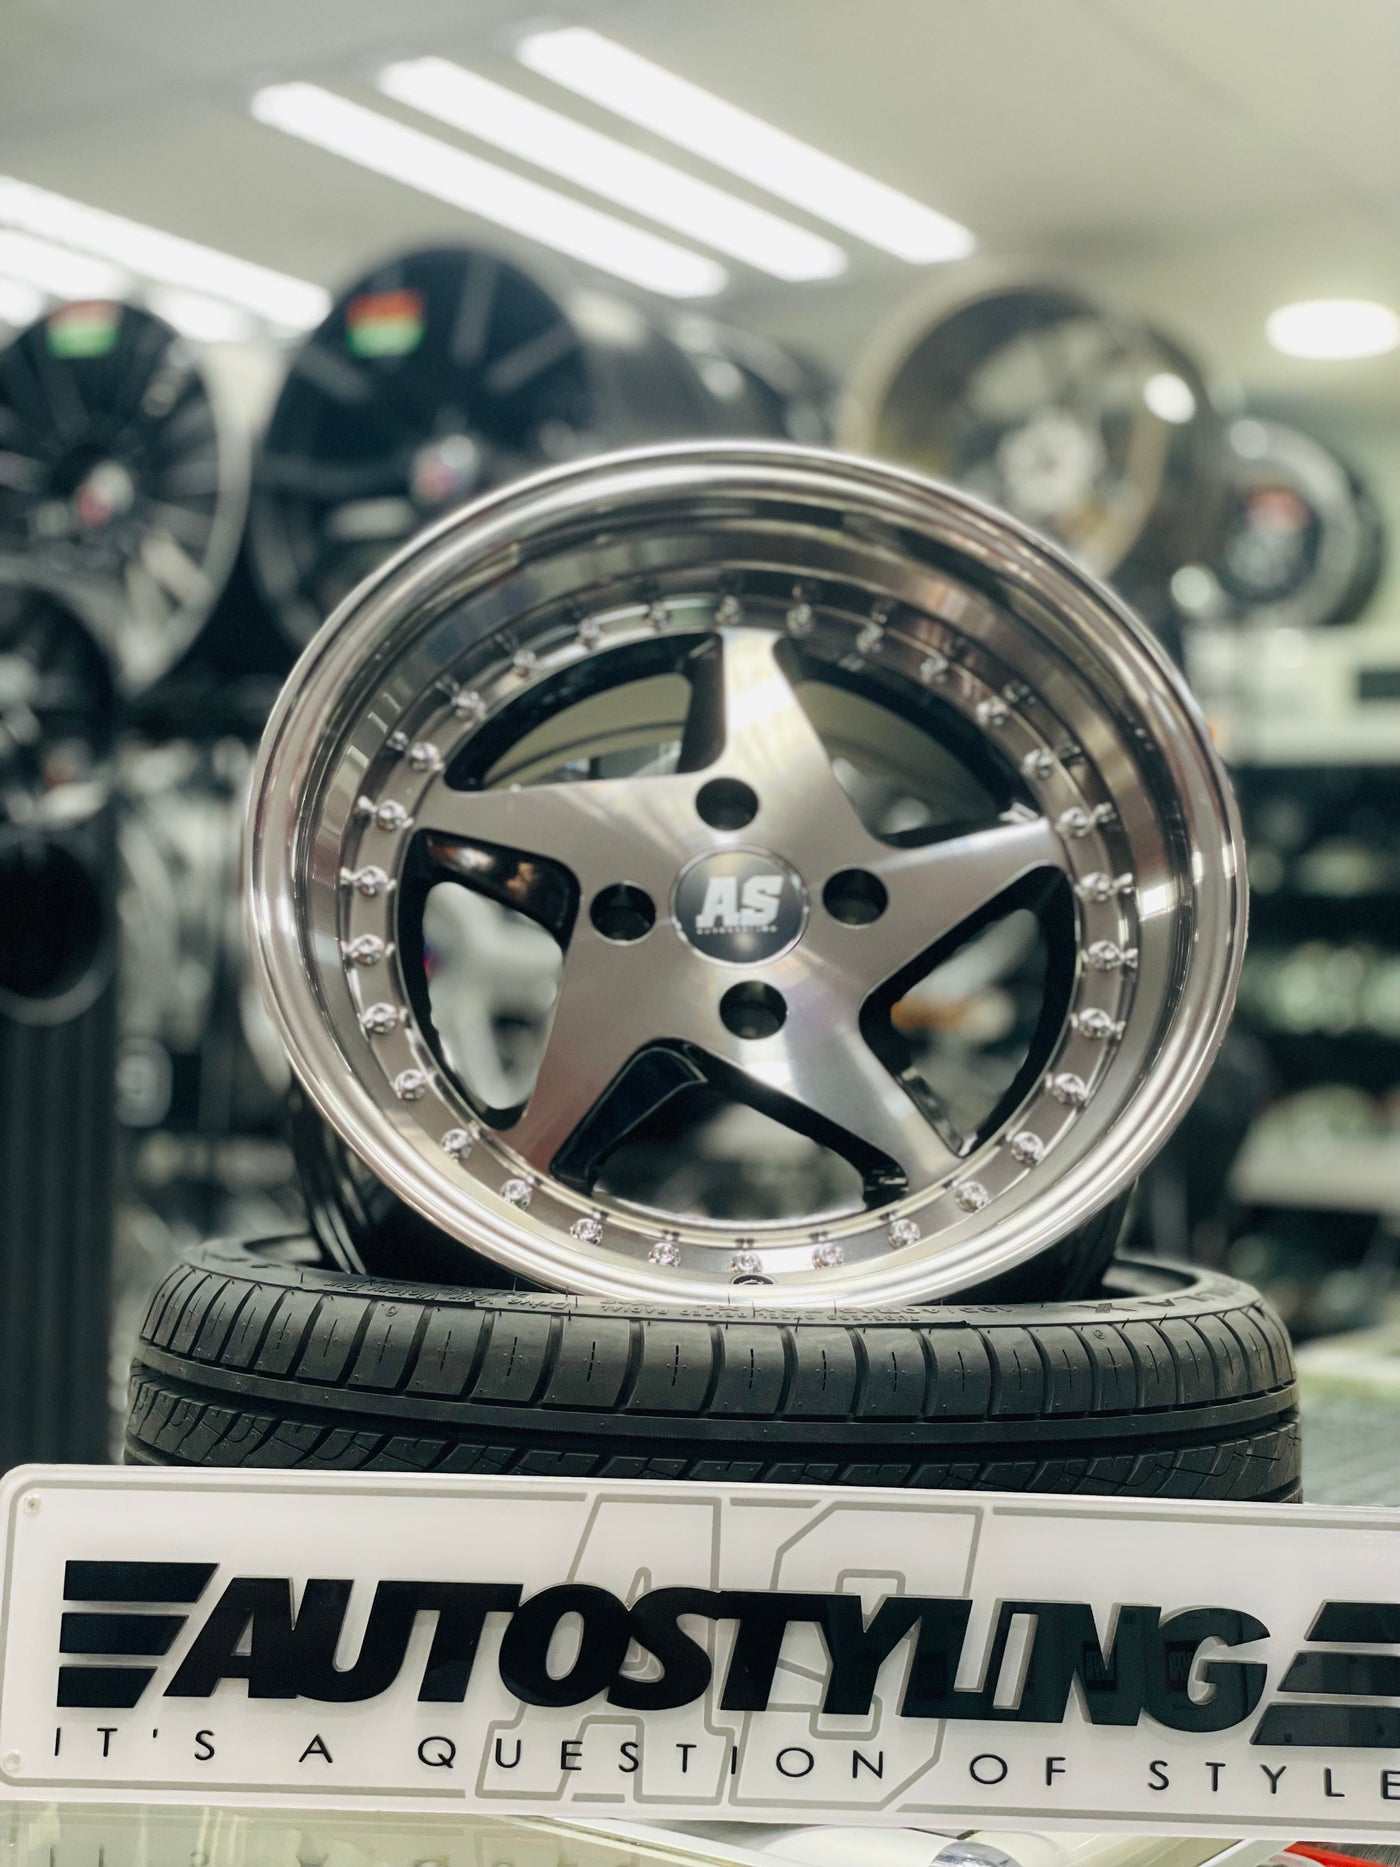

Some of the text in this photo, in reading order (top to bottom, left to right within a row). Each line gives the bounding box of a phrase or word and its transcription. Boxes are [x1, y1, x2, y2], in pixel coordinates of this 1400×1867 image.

[695, 874, 784, 929] AS
[449, 1294, 494, 1305] Your
[507, 1301, 571, 1311] Drive
[601, 1306, 668, 1316] RADIAL
[680, 1310, 747, 1319] BELTED
[163, 1576, 1270, 1733] AUTOSTYLING
[54, 1727, 1400, 1799] IT'S A QUESTION OF STYLE
